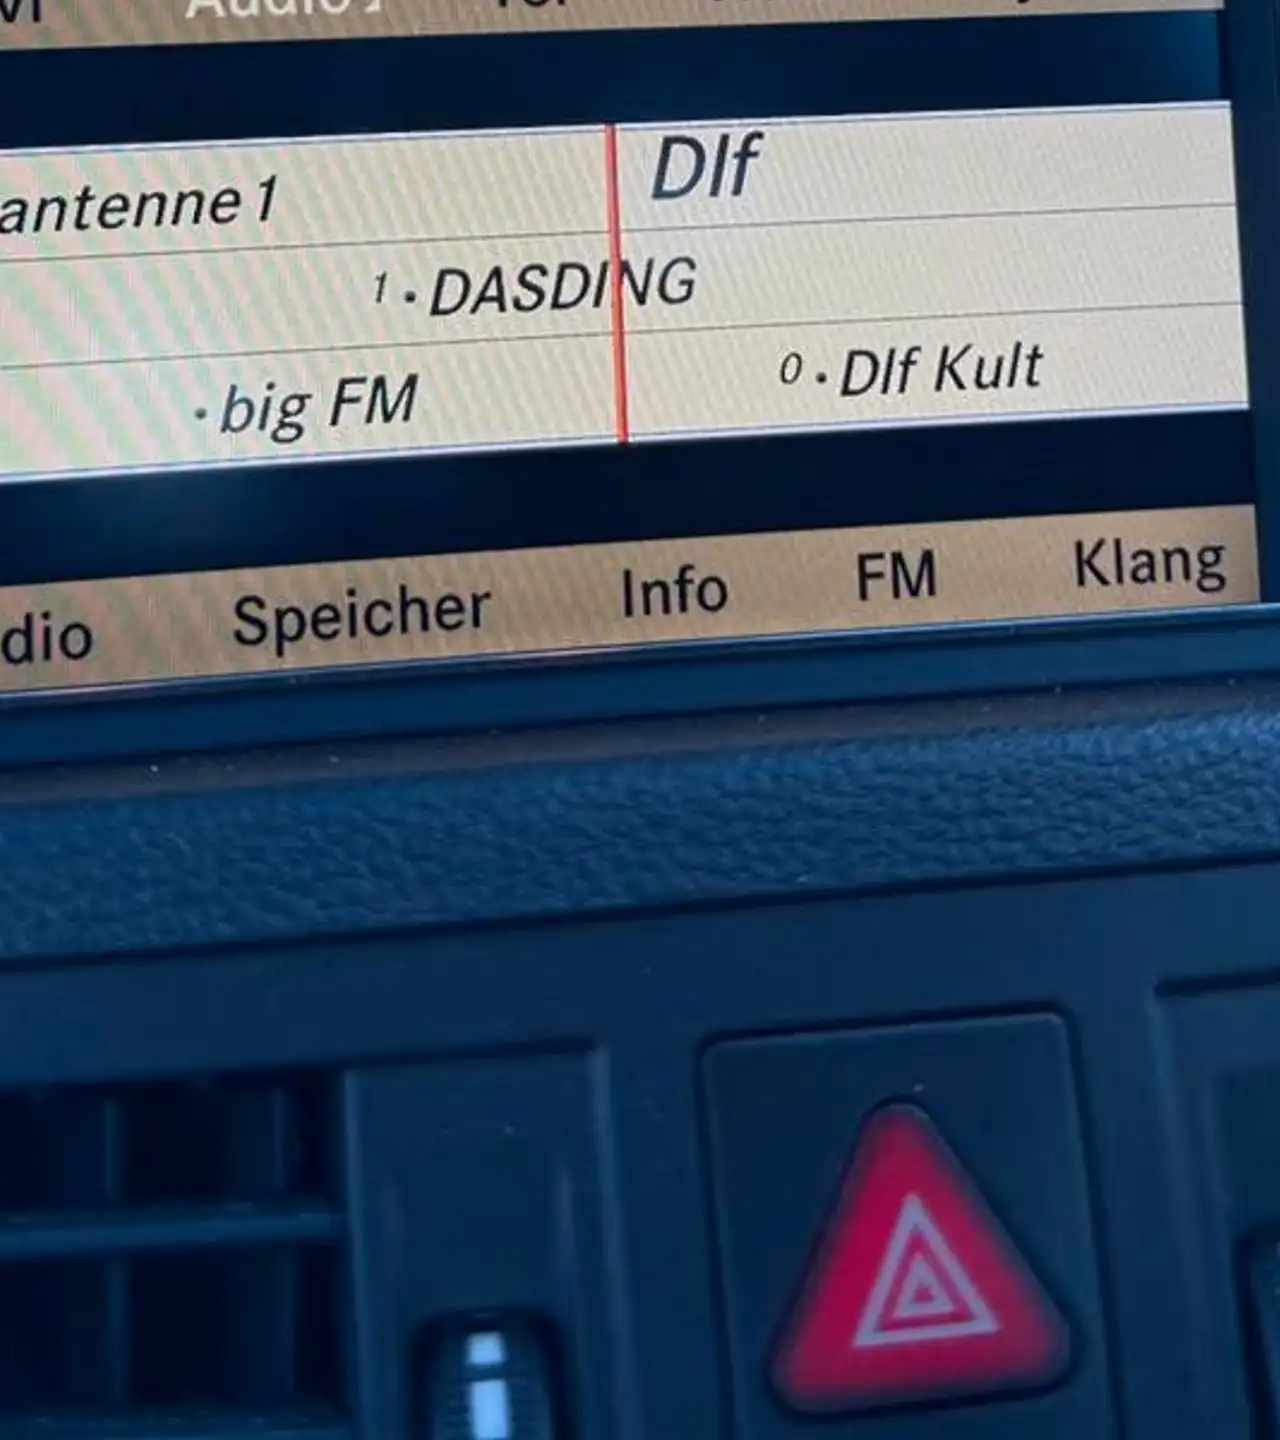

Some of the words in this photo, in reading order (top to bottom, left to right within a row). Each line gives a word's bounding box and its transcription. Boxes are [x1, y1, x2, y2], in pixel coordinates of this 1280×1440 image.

[651, 131, 764, 201] Dlf
[430, 258, 697, 316] DASDING
[934, 342, 1044, 392] Kult
[221, 383, 312, 444] big
[329, 373, 419, 428] FM
[622, 565, 729, 618] Info
[857, 549, 937, 601] FM
[1075, 536, 1227, 594] Klang
[234, 585, 492, 657] Speicher
